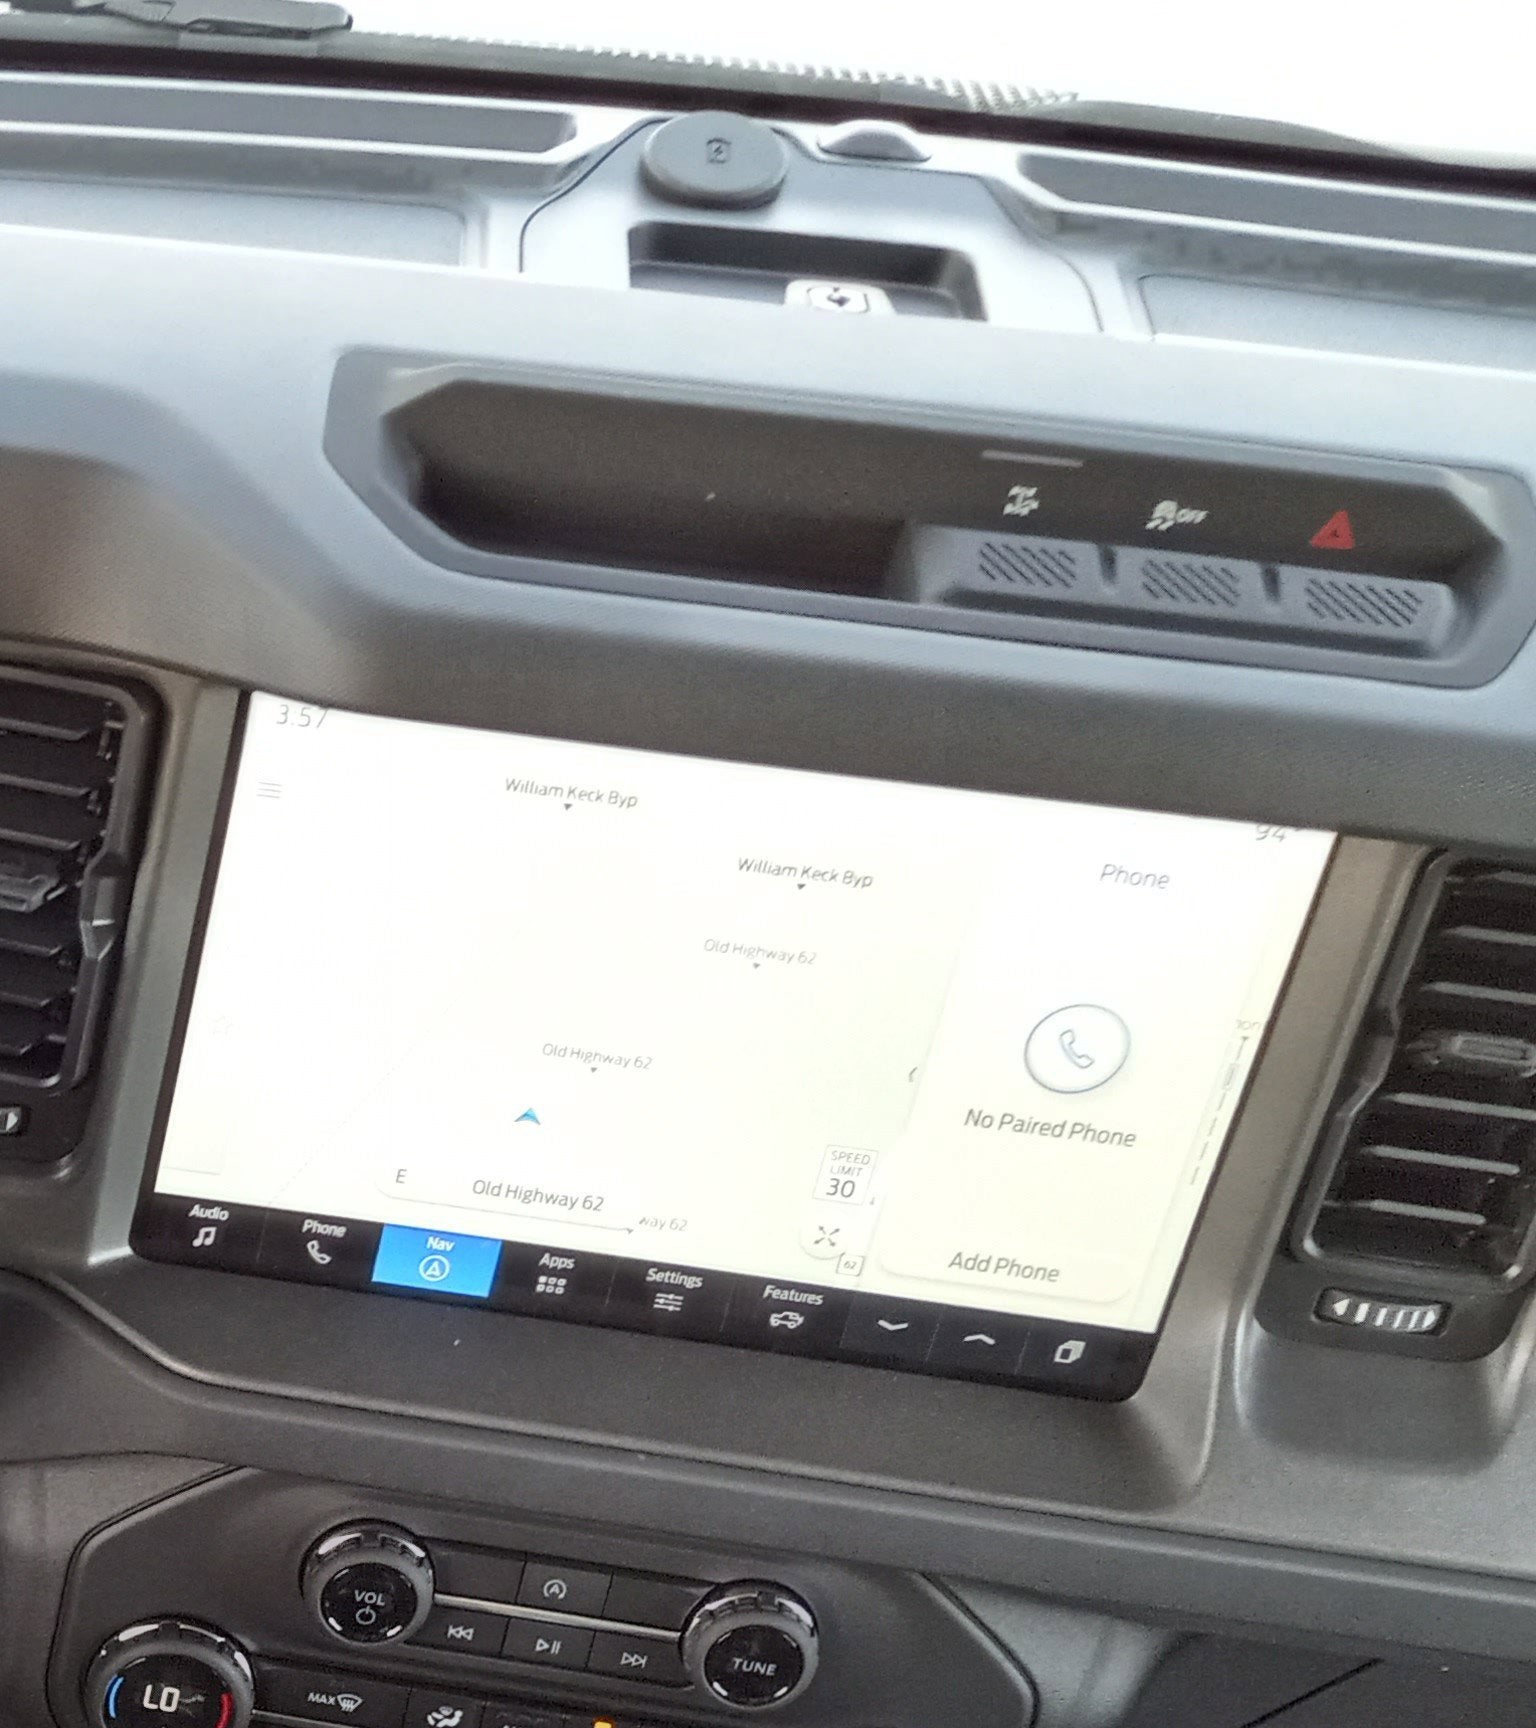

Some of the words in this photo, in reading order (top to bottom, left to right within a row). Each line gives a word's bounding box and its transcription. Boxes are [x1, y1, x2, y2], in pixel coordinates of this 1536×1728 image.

[276, 704, 328, 728] 3:57
[505, 777, 565, 802] William
[567, 784, 604, 805] Keck
[608, 788, 639, 810] Byp
[738, 857, 798, 880] William
[800, 866, 840, 884] Keck
[842, 870, 874, 890] Byp
[1100, 864, 1171, 890] Phone
[704, 937, 730, 955] Old
[731, 942, 796, 965] Highway
[798, 950, 817, 965] 62
[542, 1042, 567, 1060] Old
[569, 1045, 631, 1070] Highway
[634, 1055, 653, 1071] 62
[964, 1107, 994, 1131] No
[997, 1112, 1067, 1140] Paired
[1068, 1122, 1137, 1149] Phone
[831, 1150, 871, 1165] SPEED
[396, 1167, 407, 1185] E
[830, 1165, 864, 1178] LIMIT
[472, 1178, 501, 1198] Old
[505, 1181, 579, 1212] Highway
[582, 1194, 605, 1213] 62
[826, 1178, 856, 1198] 30
[189, 1203, 230, 1223] Audio
[303, 1218, 346, 1239] Phone
[426, 1236, 455, 1253] Nav
[539, 1252, 575, 1273] Apps
[948, 1251, 990, 1273] Add
[994, 1258, 1061, 1283] Phone
[646, 1267, 704, 1291] Settings
[762, 1284, 824, 1307] Features
[354, 1590, 386, 1606] VOL
[732, 1657, 777, 1676] TUNE
[143, 1684, 180, 1712] LO
[307, 1692, 335, 1706] MAX
